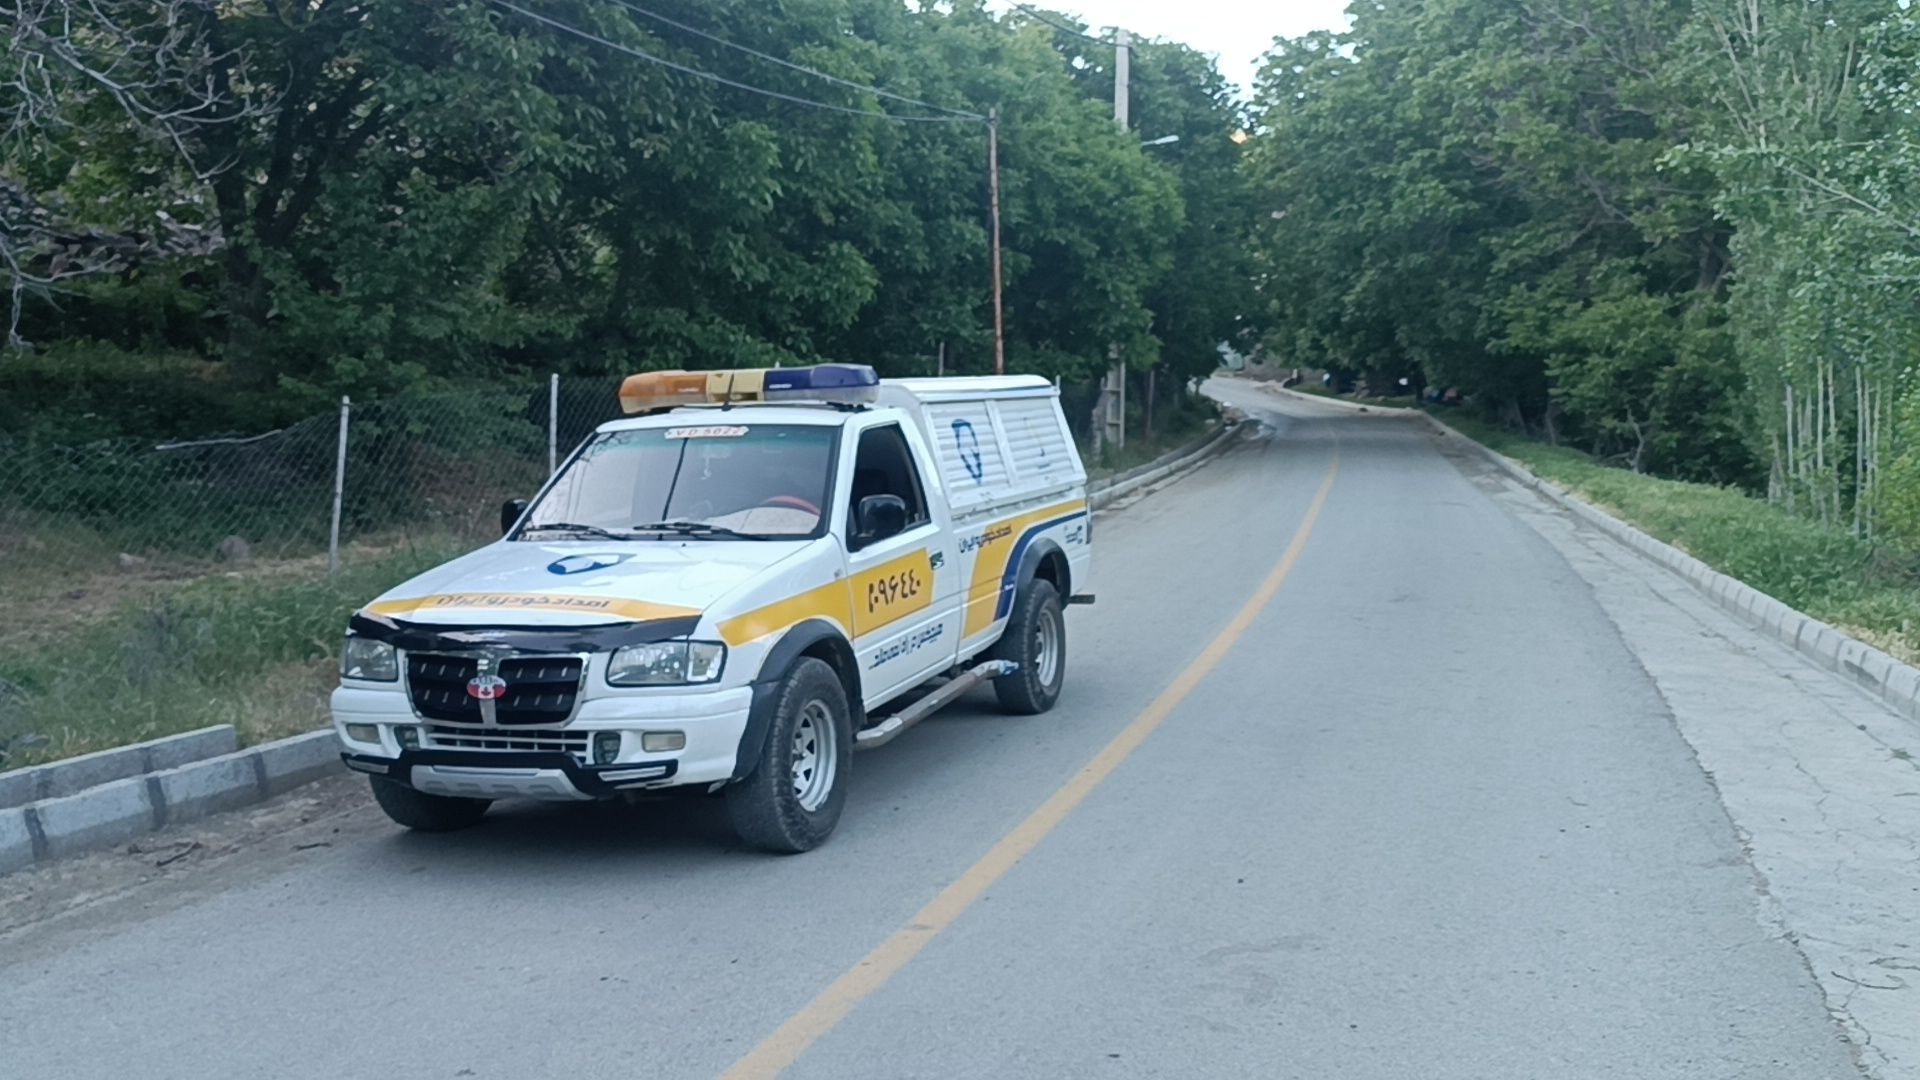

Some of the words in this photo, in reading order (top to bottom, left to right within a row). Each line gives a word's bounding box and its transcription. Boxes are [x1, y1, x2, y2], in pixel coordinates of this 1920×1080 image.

[436, 594, 488, 607] ایران
[487, 595, 550, 607] خودرو
[552, 597, 611, 608] امداد
